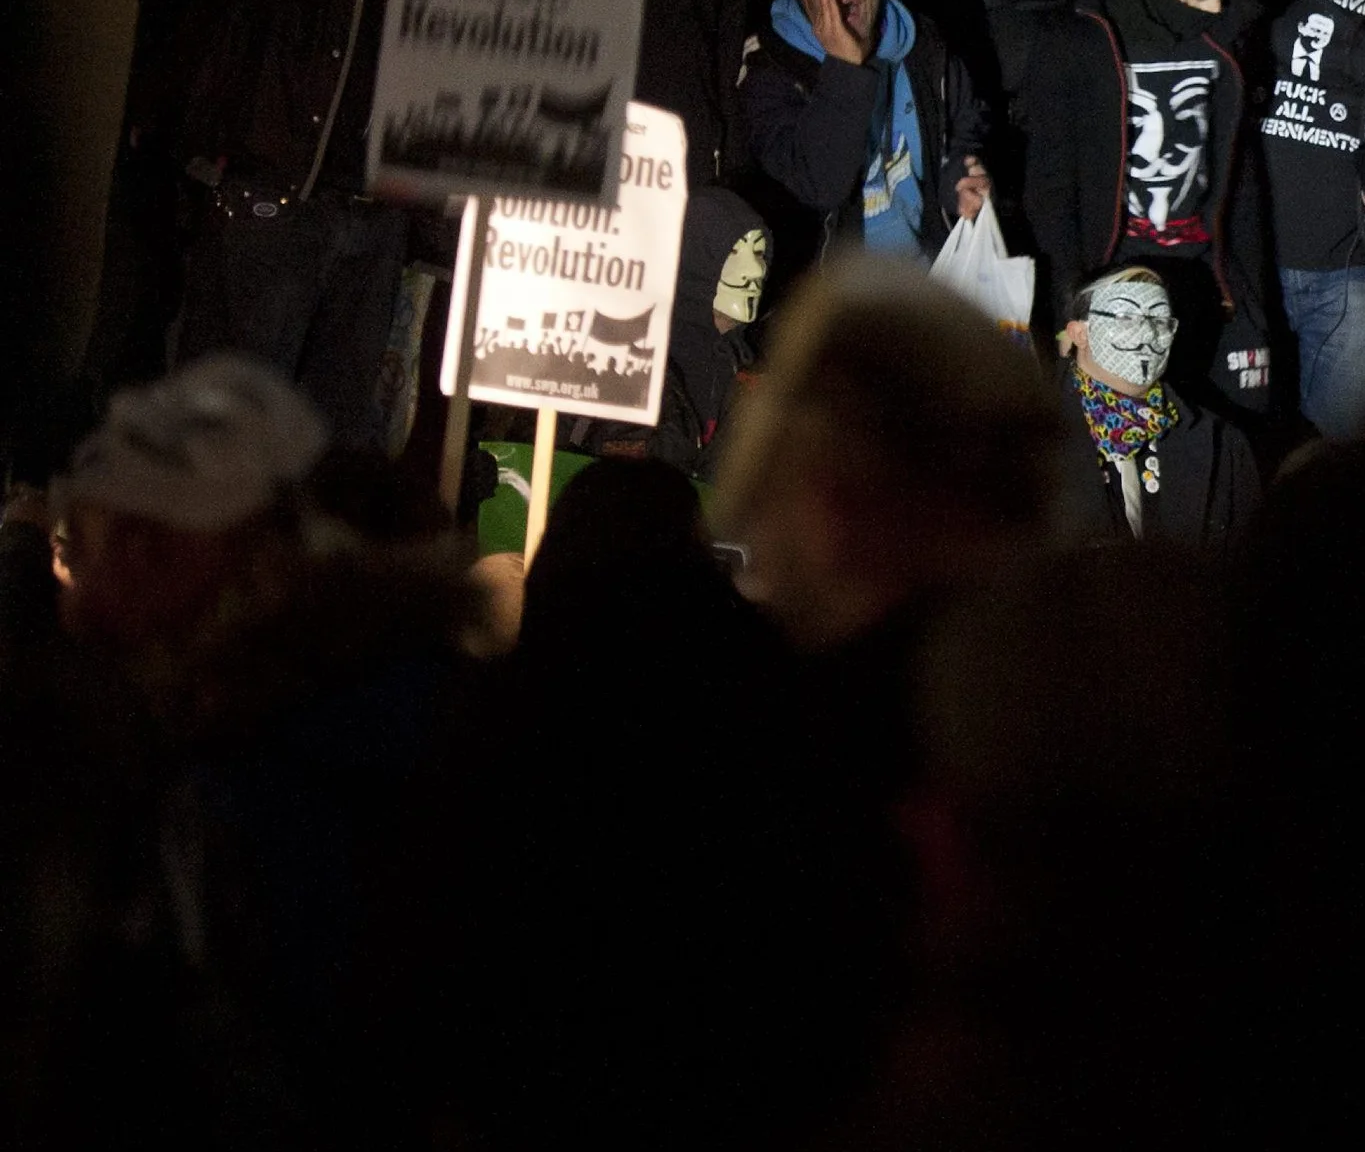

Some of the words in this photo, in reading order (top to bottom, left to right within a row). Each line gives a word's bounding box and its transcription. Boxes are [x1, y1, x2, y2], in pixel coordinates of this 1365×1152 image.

[1274, 79, 1327, 106] FUCK
[1275, 100, 1315, 124] ALL
[484, 225, 647, 292] Revolution
